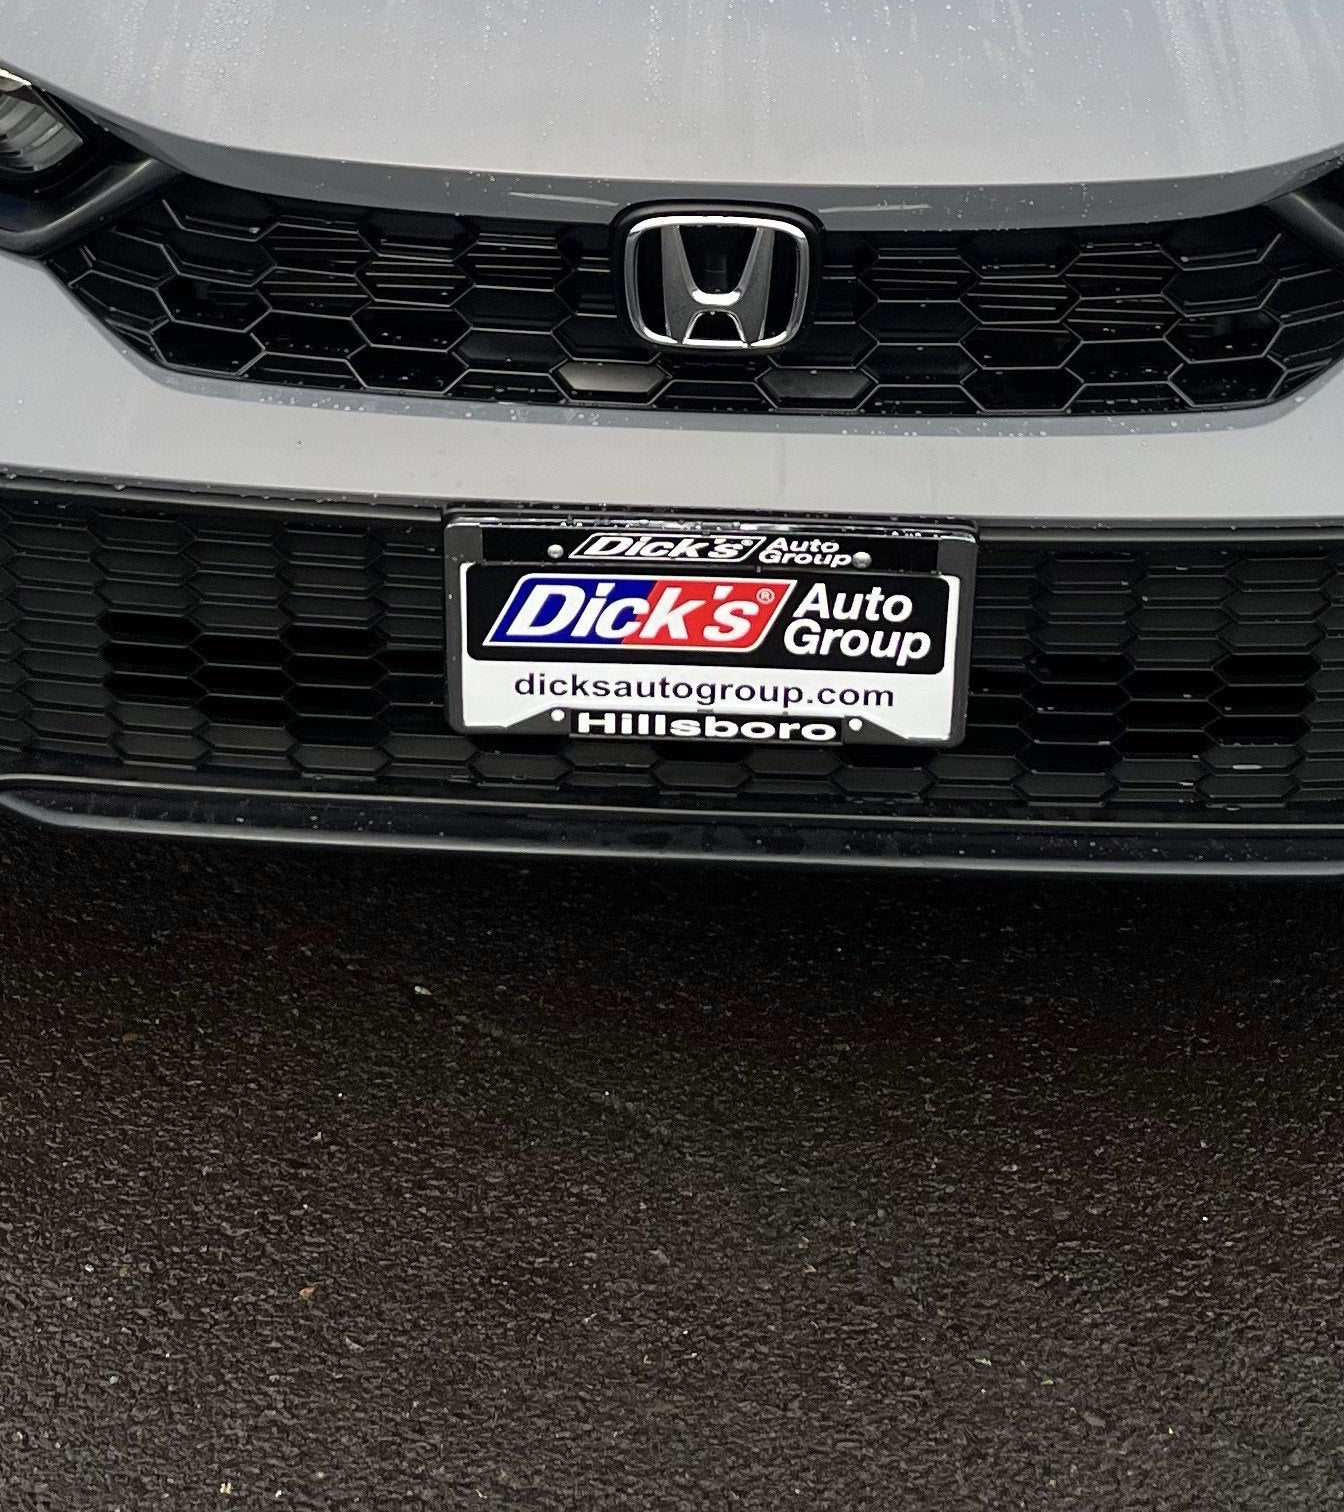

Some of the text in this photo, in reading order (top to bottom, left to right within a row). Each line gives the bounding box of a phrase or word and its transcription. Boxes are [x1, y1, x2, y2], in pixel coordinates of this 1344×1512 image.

[758, 549, 852, 568] Group
[767, 537, 840, 553] Auto
[792, 582, 913, 623] Auto
[783, 618, 931, 667] Group
[514, 672, 895, 708] dicksautogroup.com
[578, 711, 837, 742] Hillsboro
